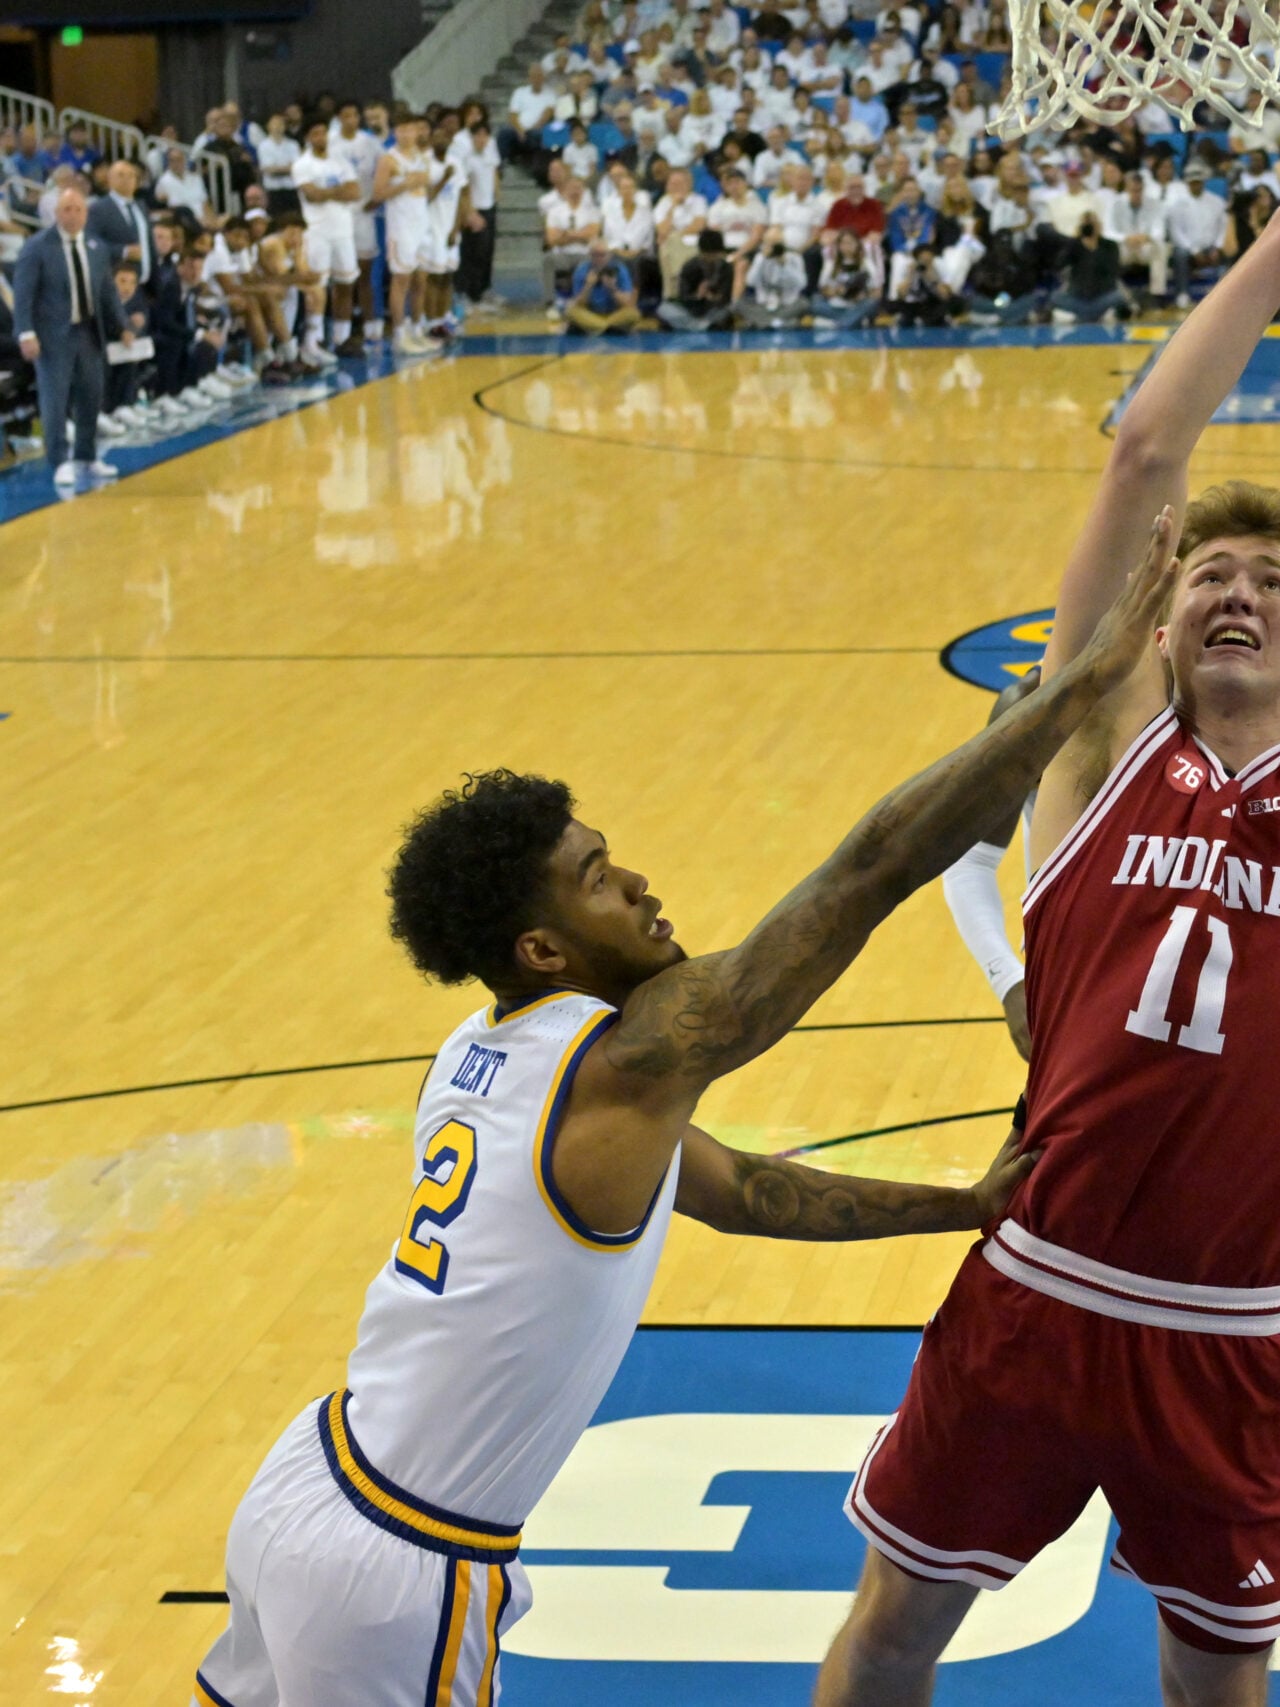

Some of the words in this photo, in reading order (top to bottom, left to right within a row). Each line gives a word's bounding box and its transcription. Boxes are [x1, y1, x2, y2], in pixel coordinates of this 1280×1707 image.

[1125, 905, 1233, 1055] 11
[450, 1042, 508, 1098] DENT
[395, 1117, 478, 1296] 2
